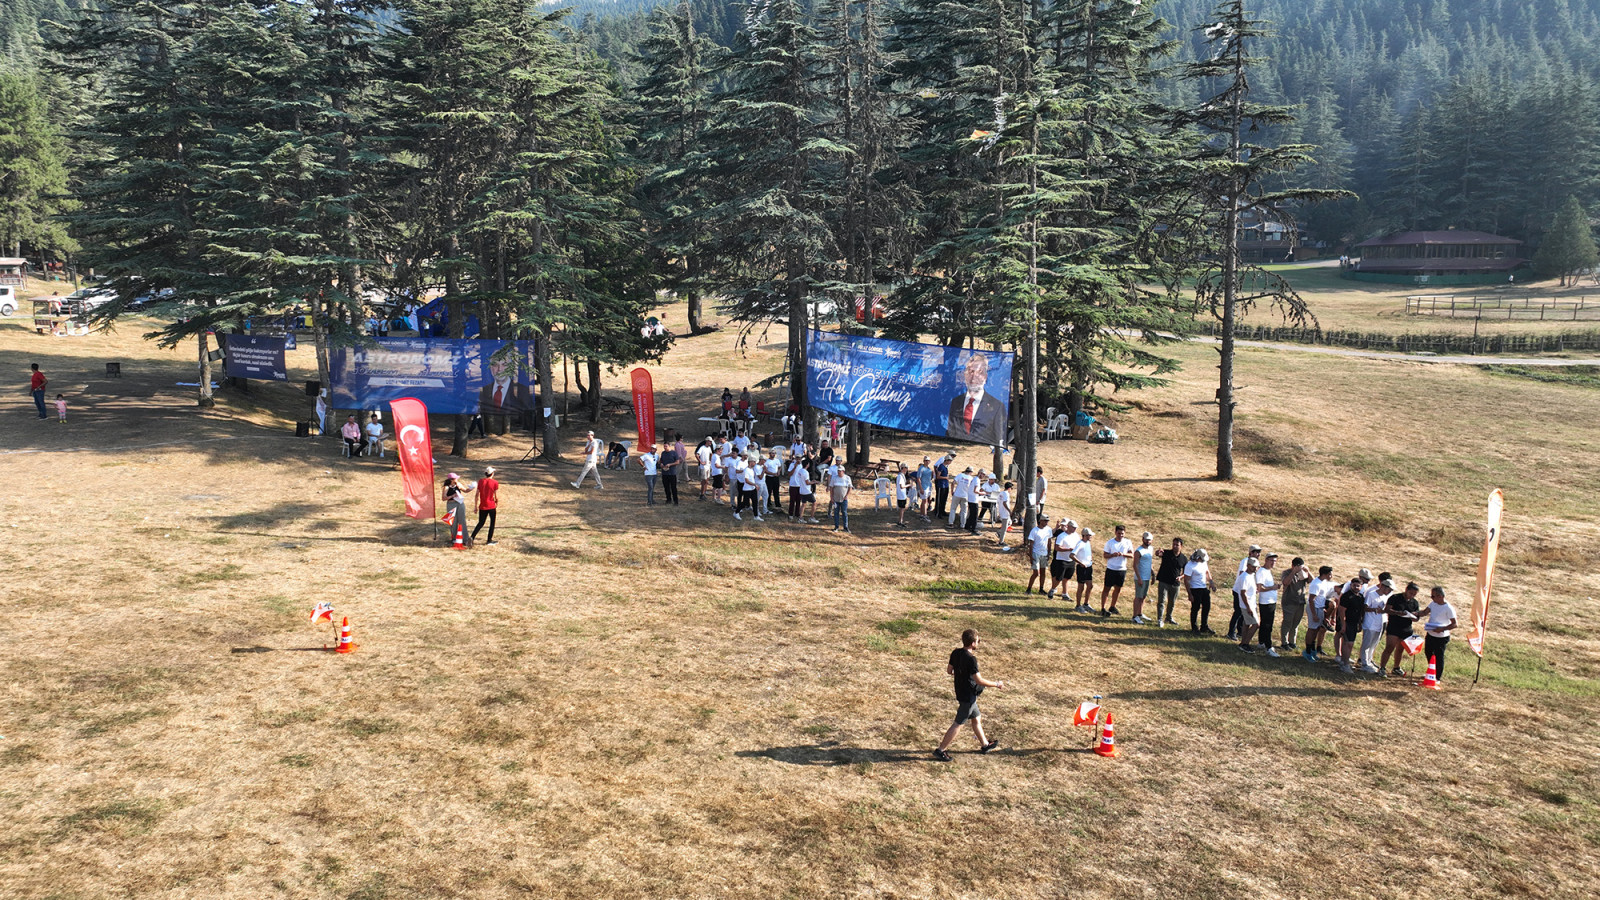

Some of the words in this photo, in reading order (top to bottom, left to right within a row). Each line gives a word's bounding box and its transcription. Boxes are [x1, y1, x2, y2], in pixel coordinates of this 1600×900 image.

[352, 350, 463, 366] ASTRONOMİ
[807, 358, 852, 377] ASTRONOMİ
[816, 368, 847, 402] Hoş
[849, 372, 911, 415] Geldiniz
